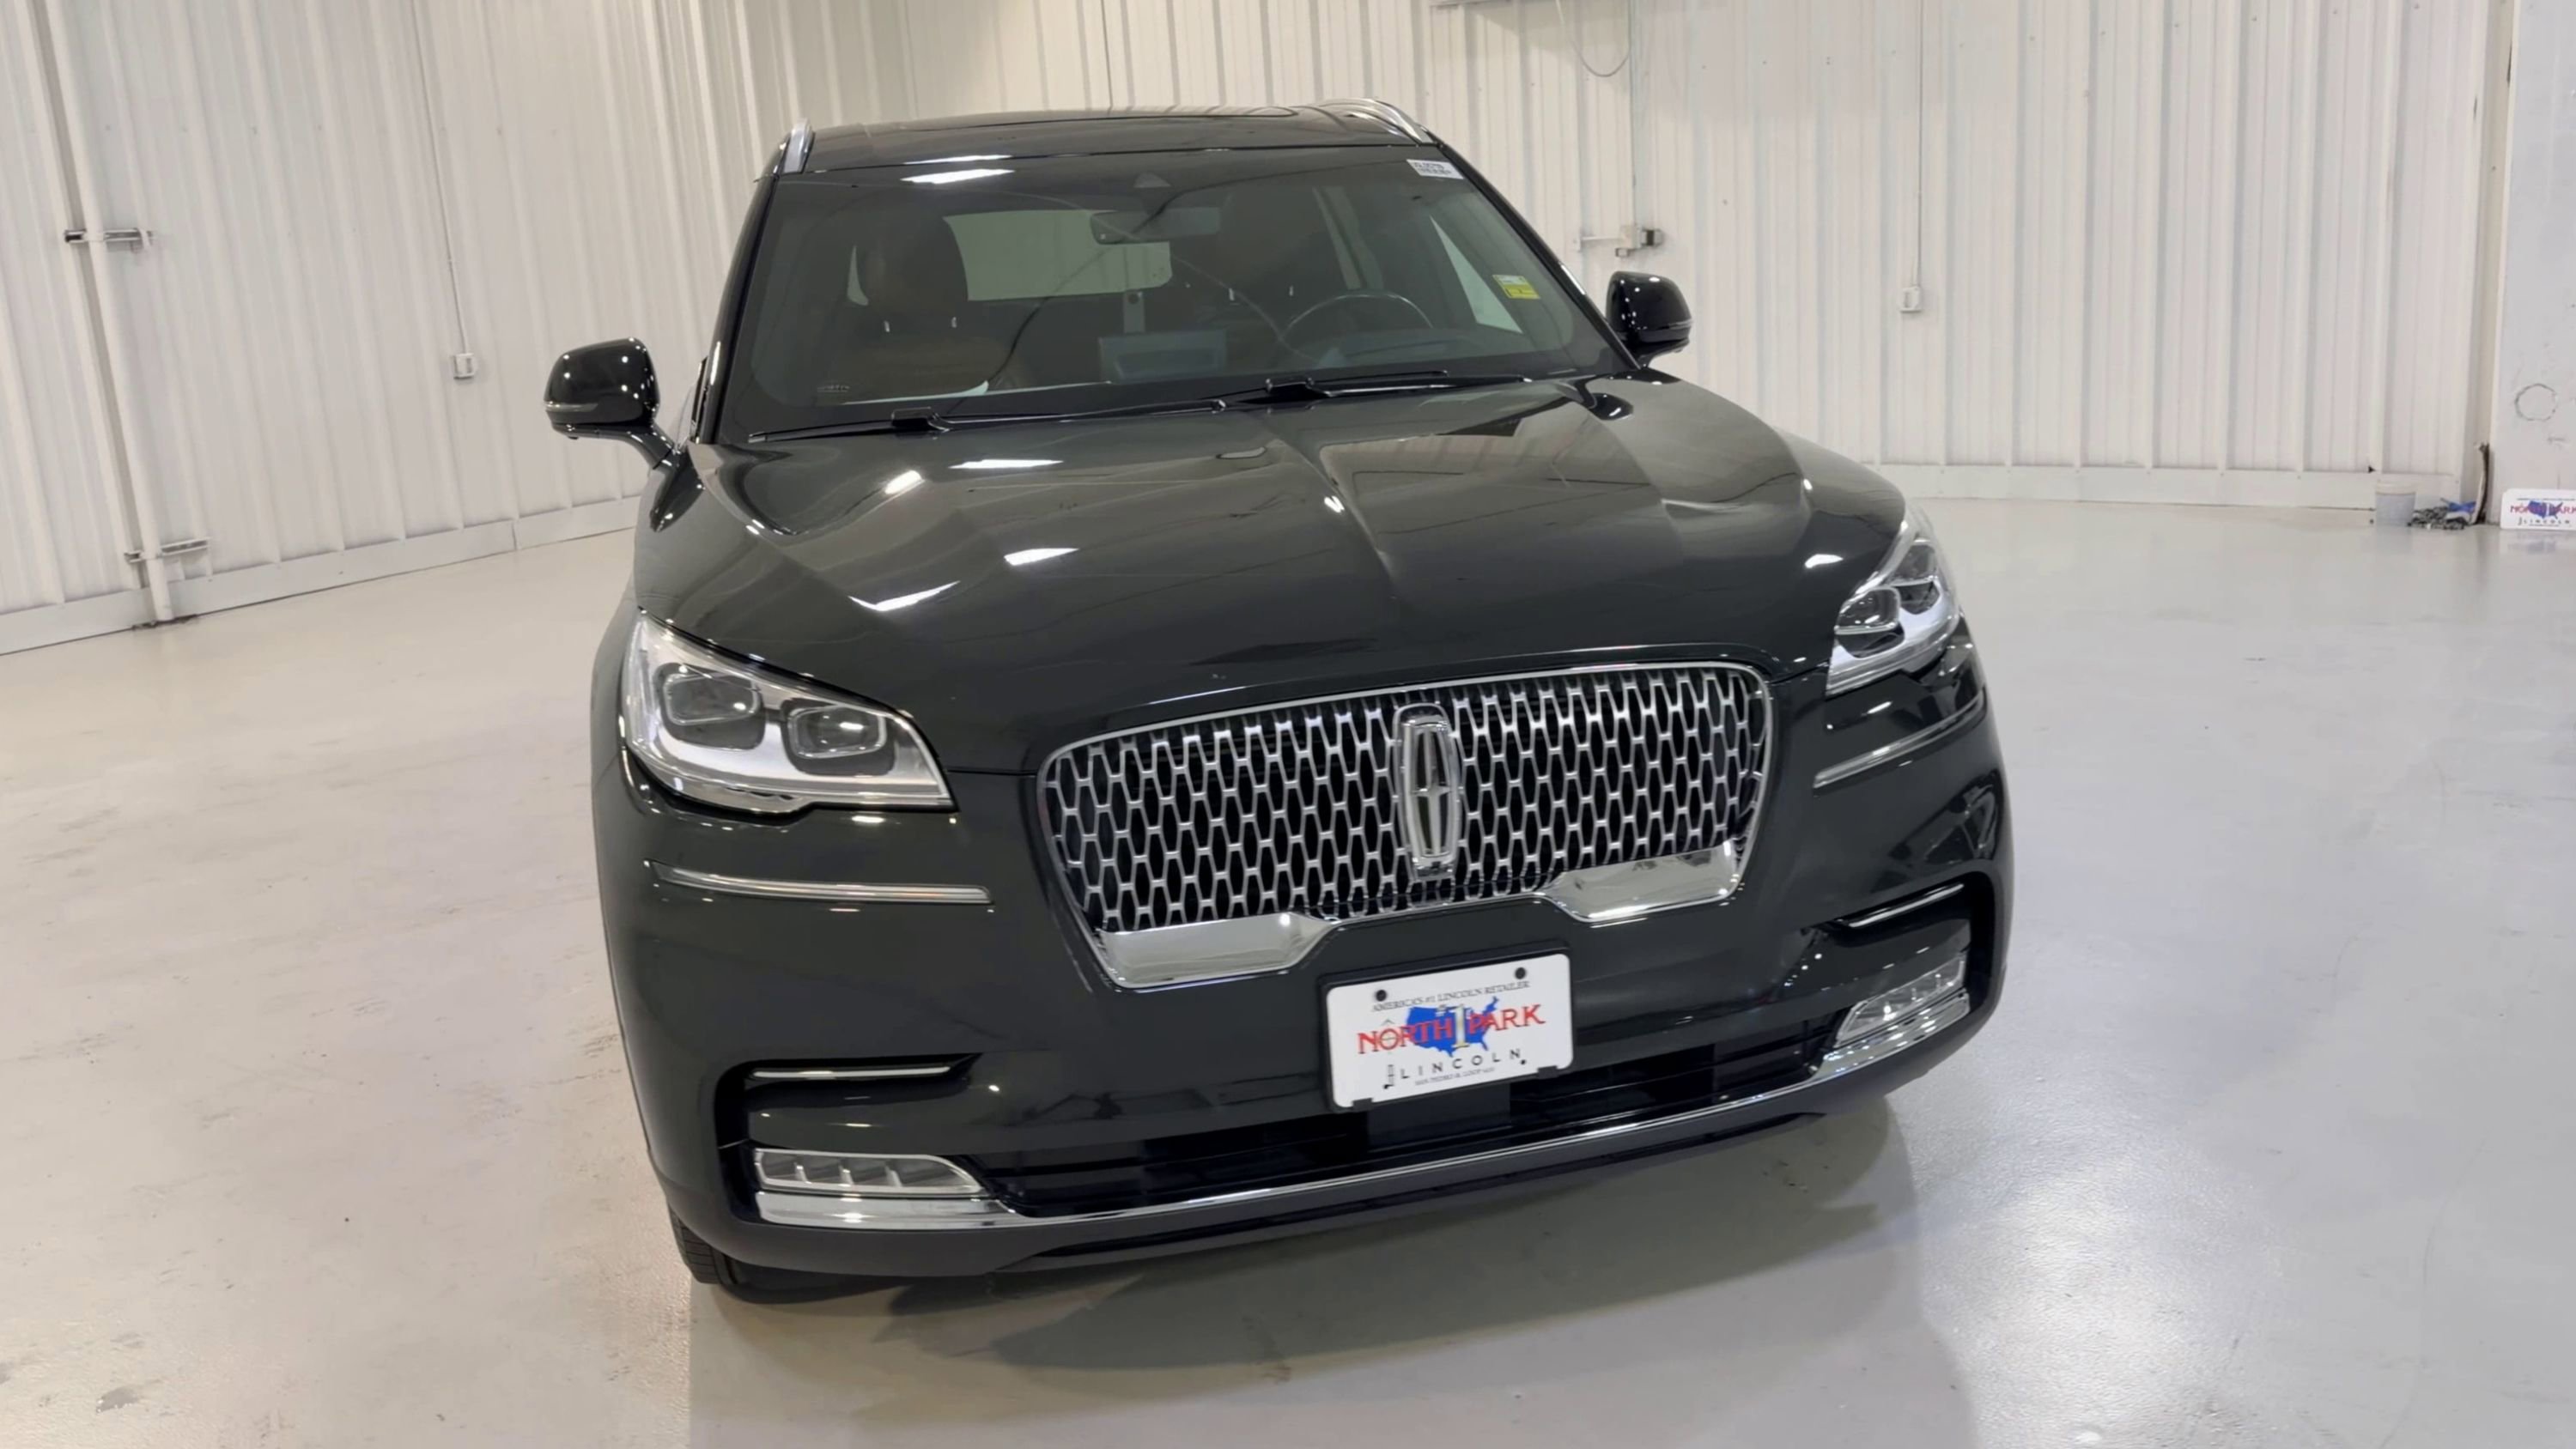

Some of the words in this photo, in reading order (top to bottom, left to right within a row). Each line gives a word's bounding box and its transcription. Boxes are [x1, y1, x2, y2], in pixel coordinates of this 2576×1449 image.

[1437, 988, 1482, 1001] LINCOLN
[1358, 1017, 1452, 1054] NORTH
[1469, 1003, 1546, 1034] PARK
[1400, 1048, 1521, 1079] LINCOLN
